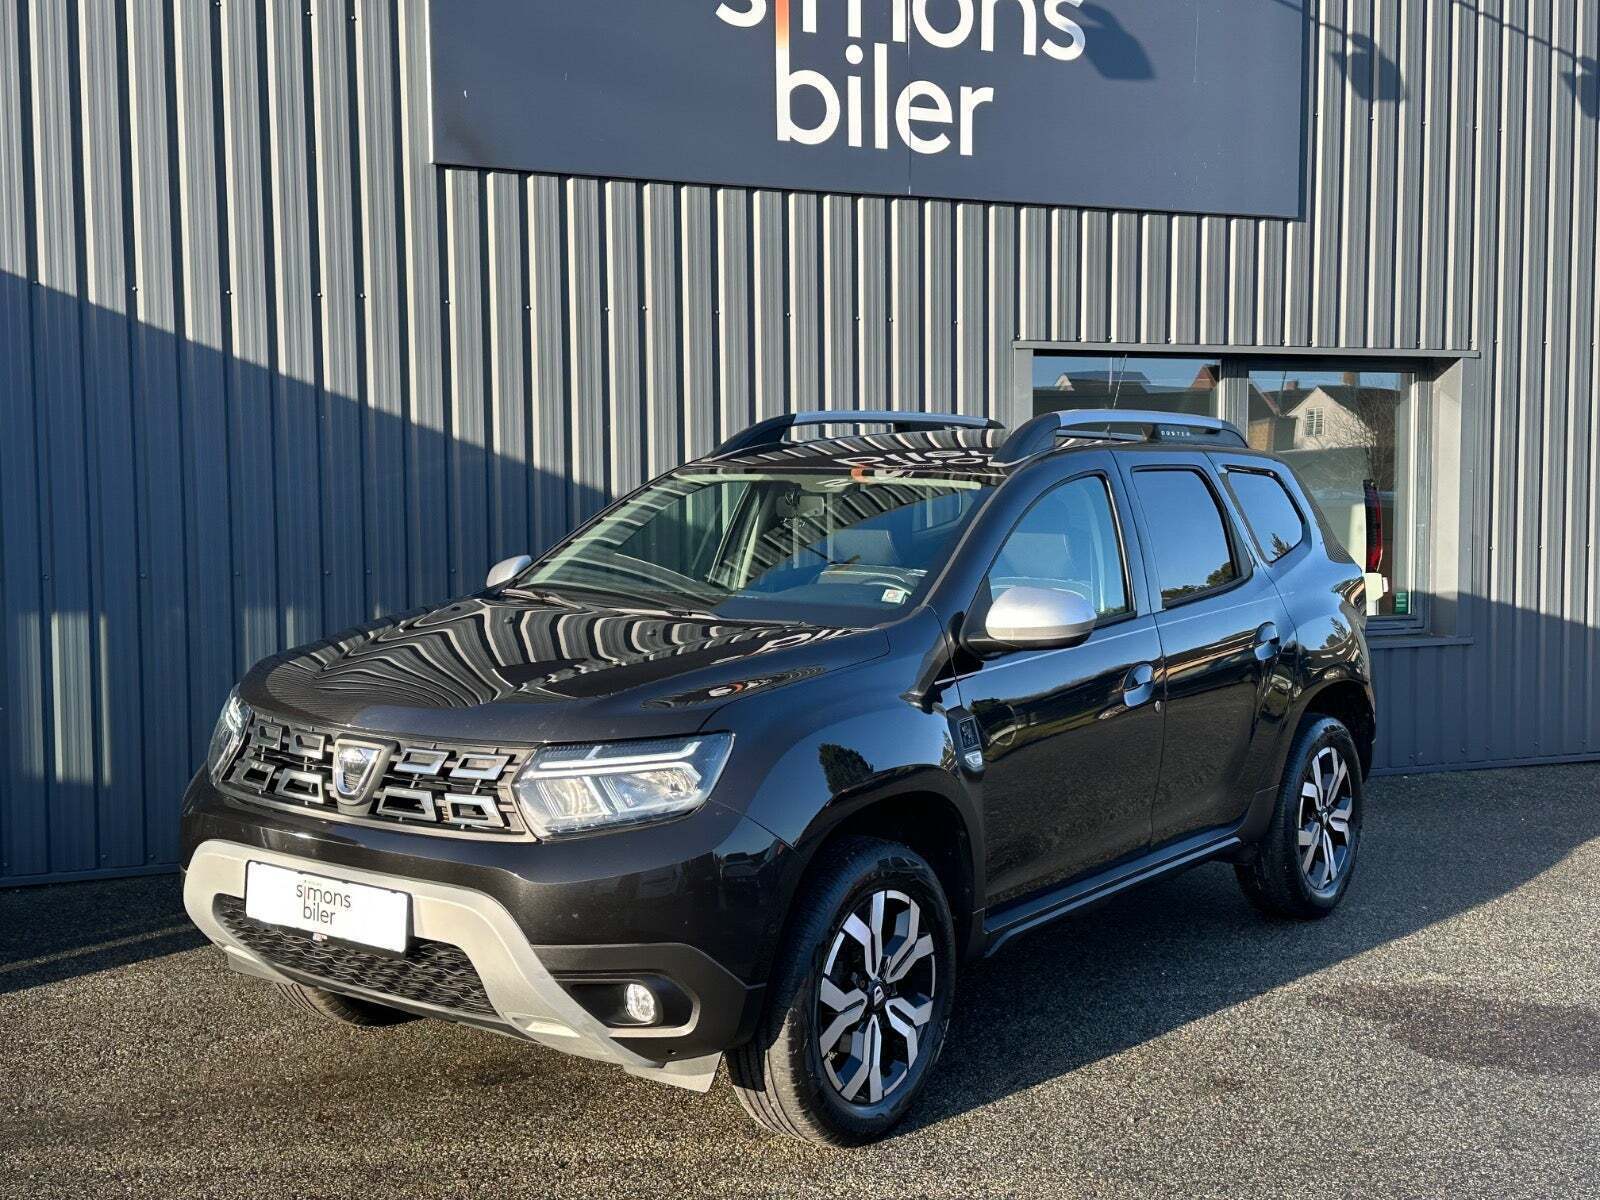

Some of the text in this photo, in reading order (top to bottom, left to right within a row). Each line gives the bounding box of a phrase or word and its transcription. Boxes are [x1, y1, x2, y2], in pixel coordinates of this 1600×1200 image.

[775, 43, 994, 156] biler
[296, 880, 352, 908] simons
[303, 902, 336, 925] biler
